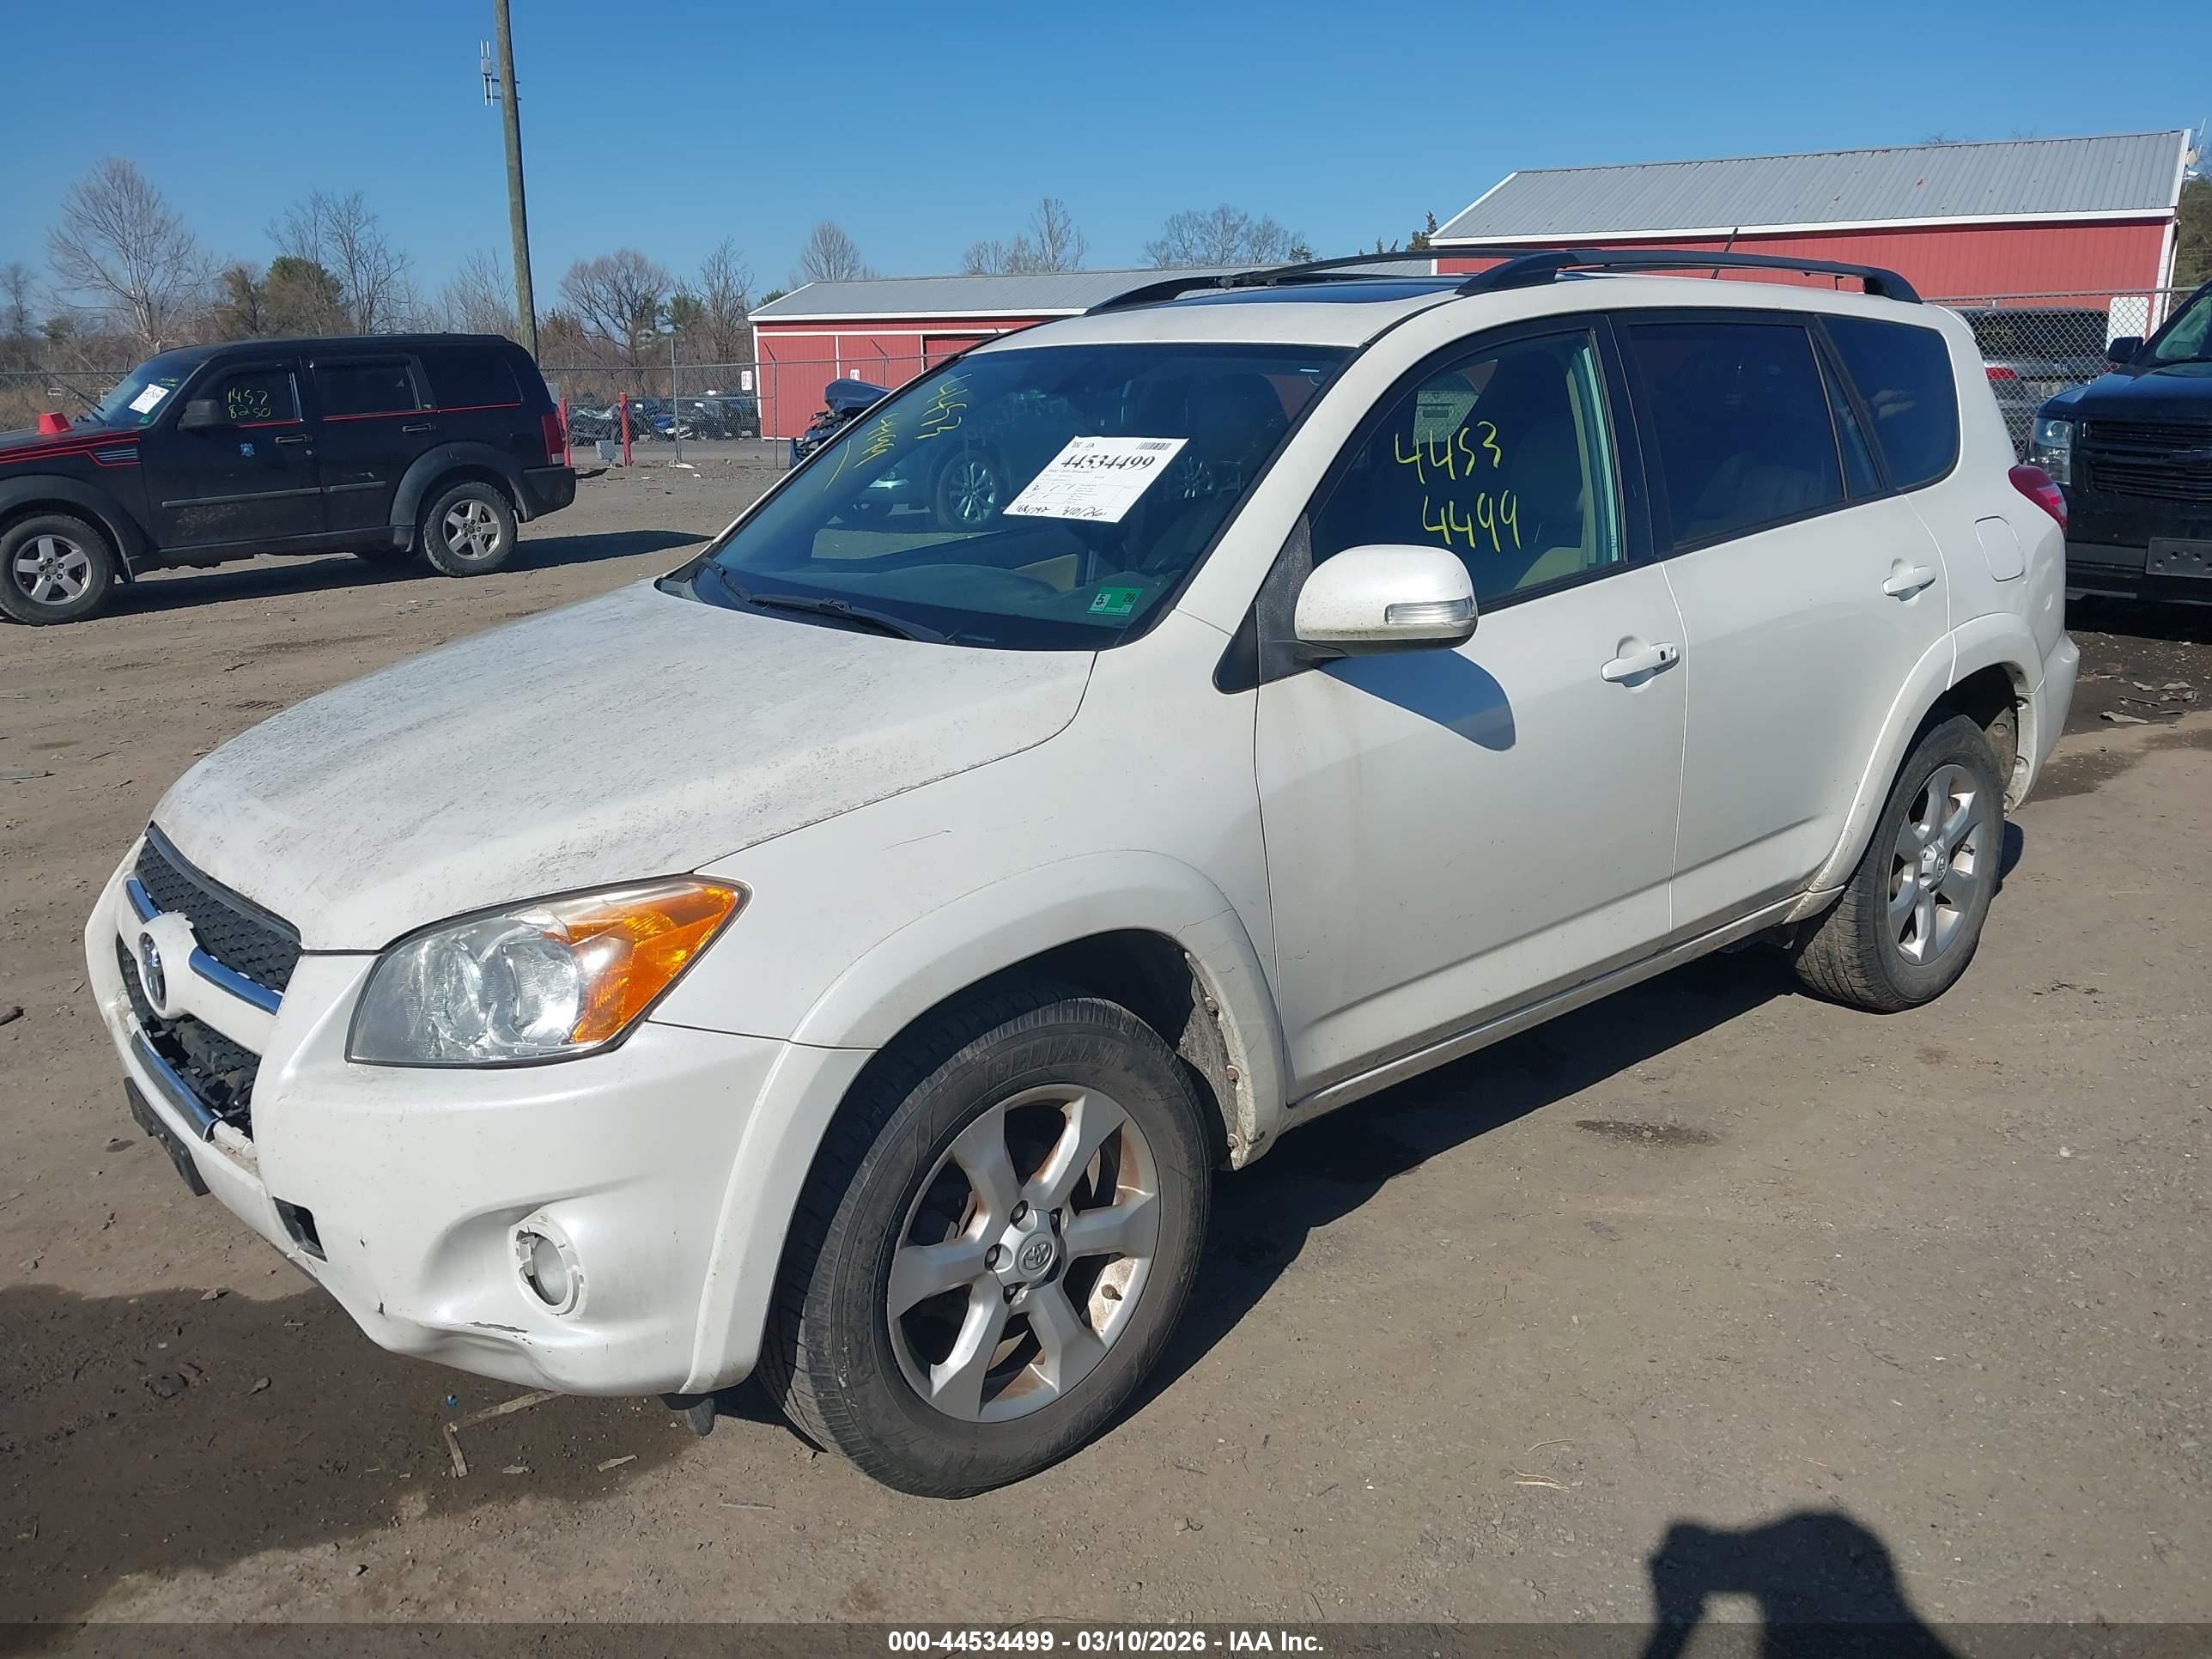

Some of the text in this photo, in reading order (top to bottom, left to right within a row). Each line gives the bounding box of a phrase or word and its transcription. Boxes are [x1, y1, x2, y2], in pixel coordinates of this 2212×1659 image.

[915, 374, 972, 440] 4453
[1060, 454, 1156, 471] 44534499
[1395, 421, 1502, 484] 4453
[1422, 489, 1521, 552] 4499
[1096, 591, 1137, 606] 5 26
